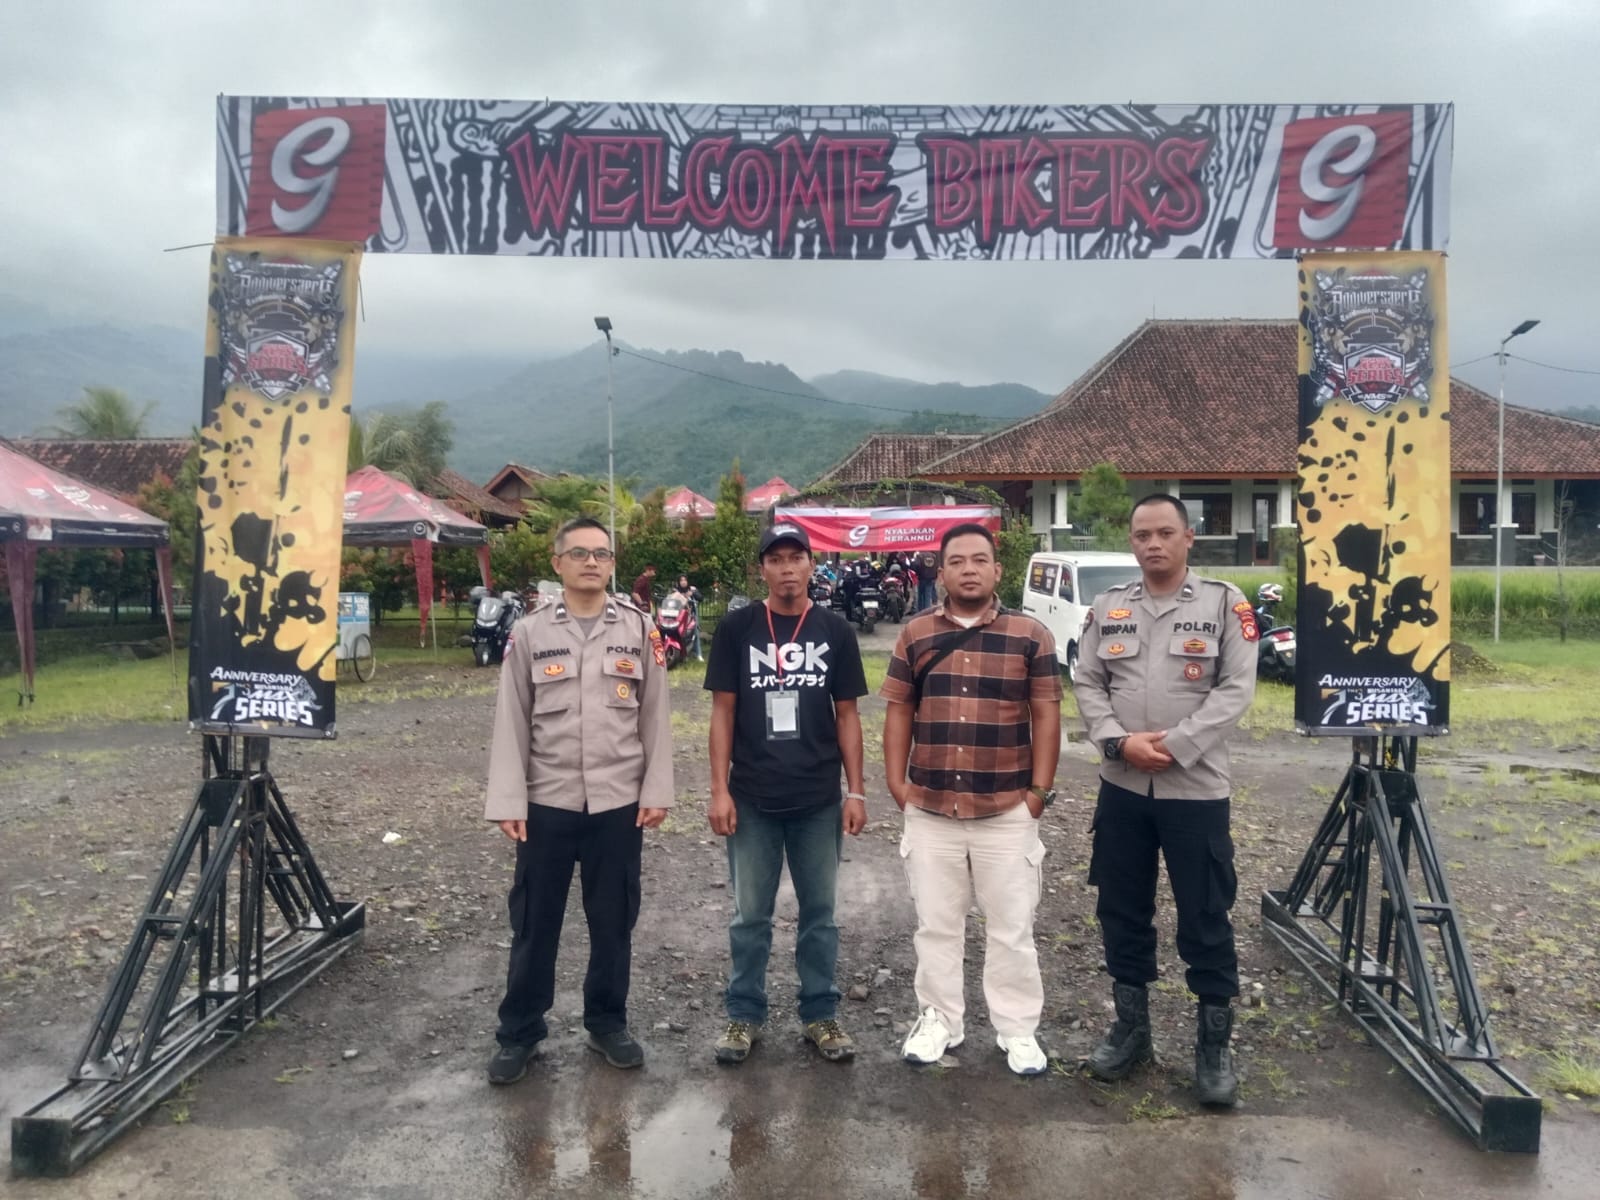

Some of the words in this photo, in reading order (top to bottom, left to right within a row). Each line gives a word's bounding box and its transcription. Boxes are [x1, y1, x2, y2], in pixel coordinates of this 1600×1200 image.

[507, 132, 894, 256] WELCOME
[923, 136, 1209, 243] BIKERS
[884, 527, 936, 536] NYALAKAN
[1173, 621, 1217, 635] POLRI
[606, 645, 642, 656] POLRI
[749, 641, 830, 673] NGK
[235, 698, 313, 726] SERIES
[1346, 702, 1428, 725] SERIES
